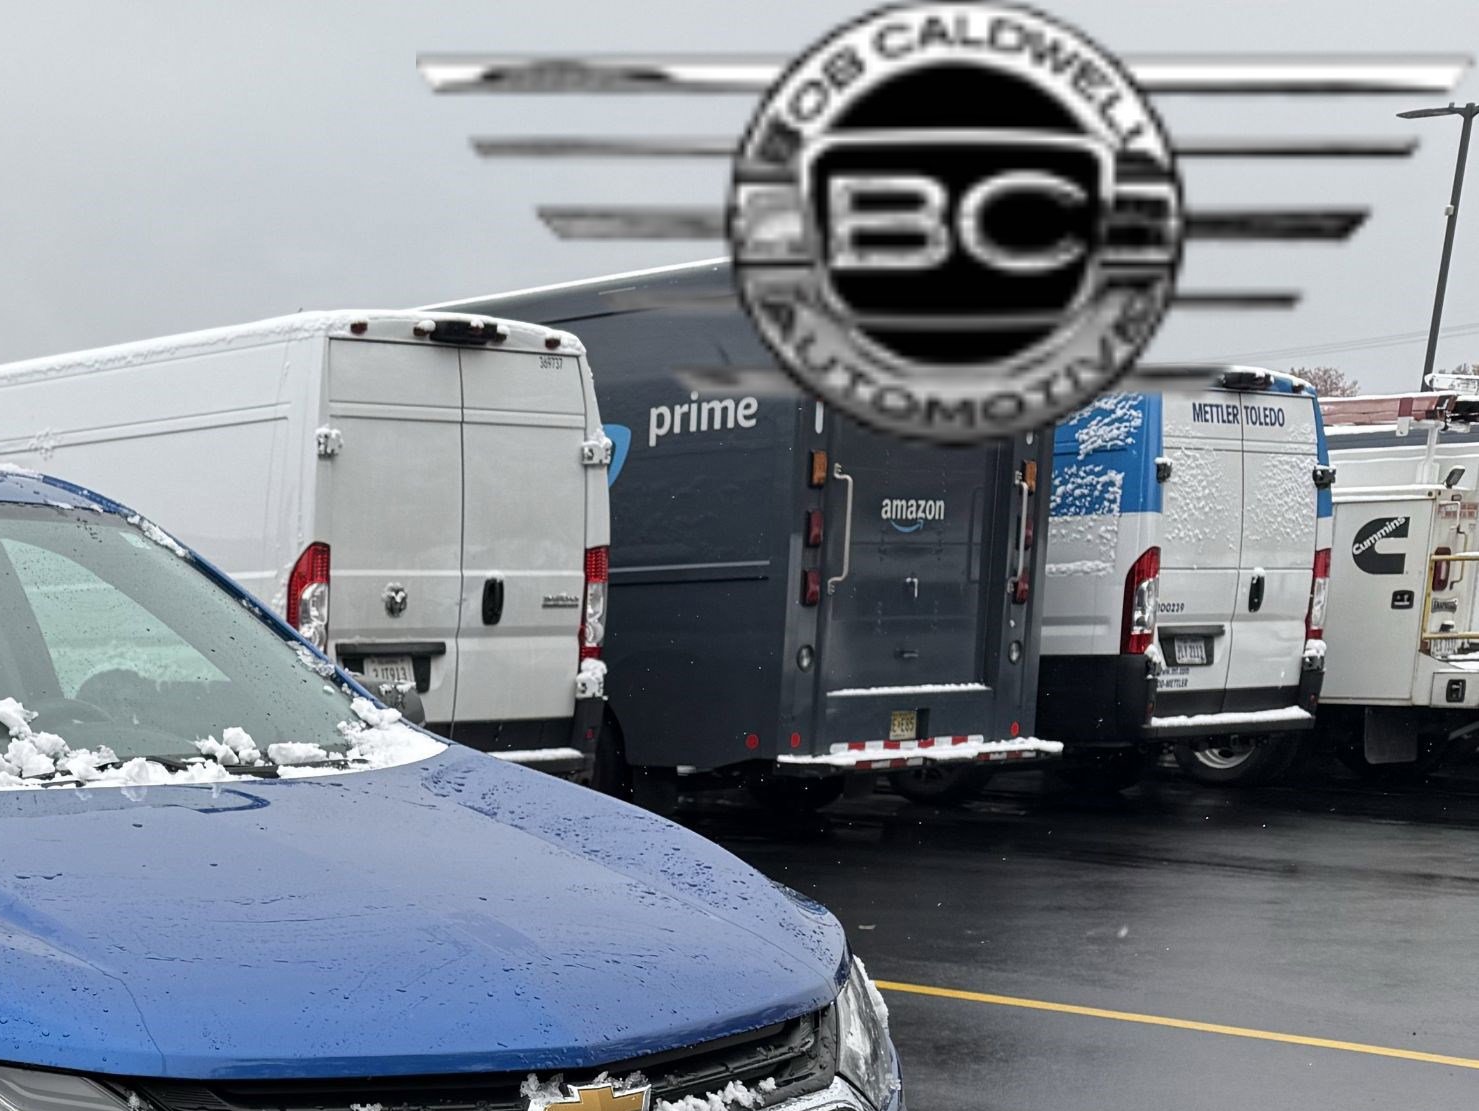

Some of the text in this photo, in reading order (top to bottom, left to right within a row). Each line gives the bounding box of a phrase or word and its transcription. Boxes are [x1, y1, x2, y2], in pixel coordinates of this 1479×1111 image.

[648, 391, 759, 447] prime
[1192, 402, 1286, 429] METTLER TOLEDO
[881, 498, 945, 521] amazon
[1352, 516, 1406, 555] Cummins
